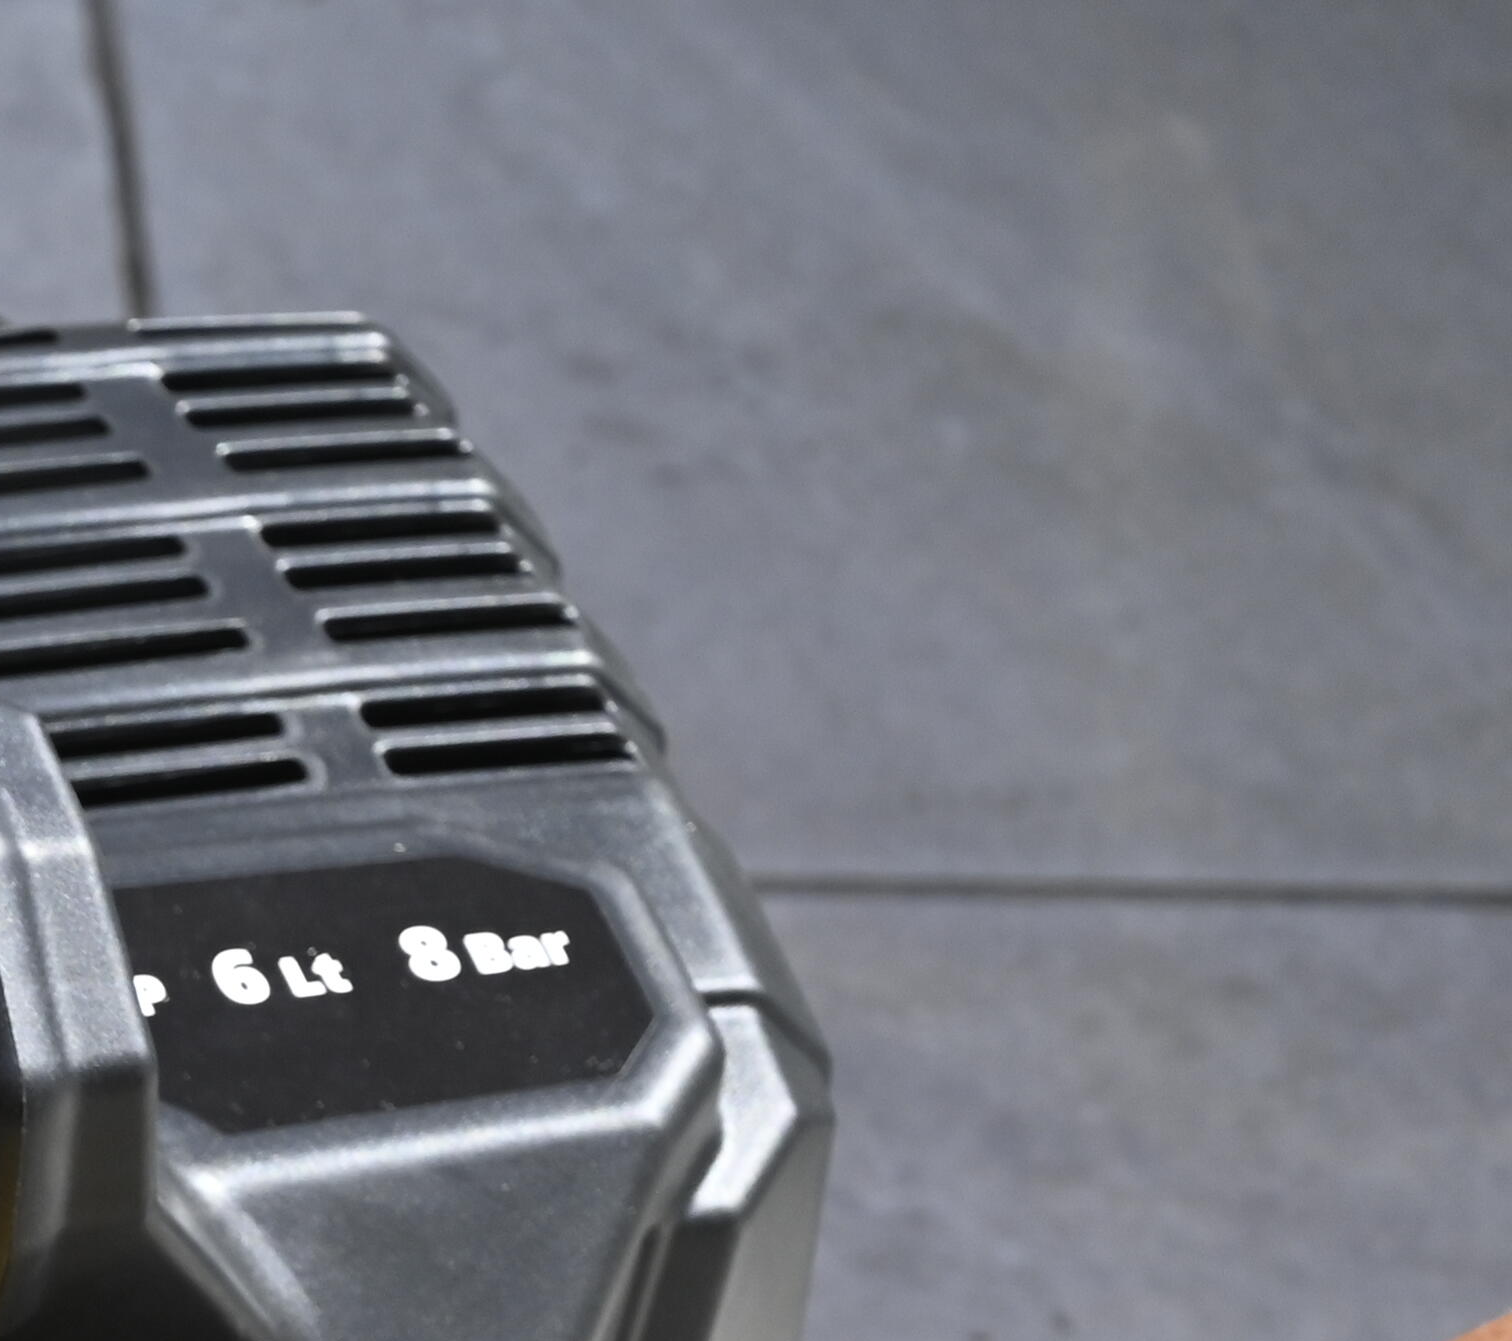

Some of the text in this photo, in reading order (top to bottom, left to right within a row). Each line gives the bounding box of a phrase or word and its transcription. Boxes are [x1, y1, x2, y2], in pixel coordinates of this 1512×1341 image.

[211, 948, 270, 1005] 6
[277, 951, 353, 999] Lt
[398, 925, 462, 983] 8
[463, 929, 571, 976] Bar
